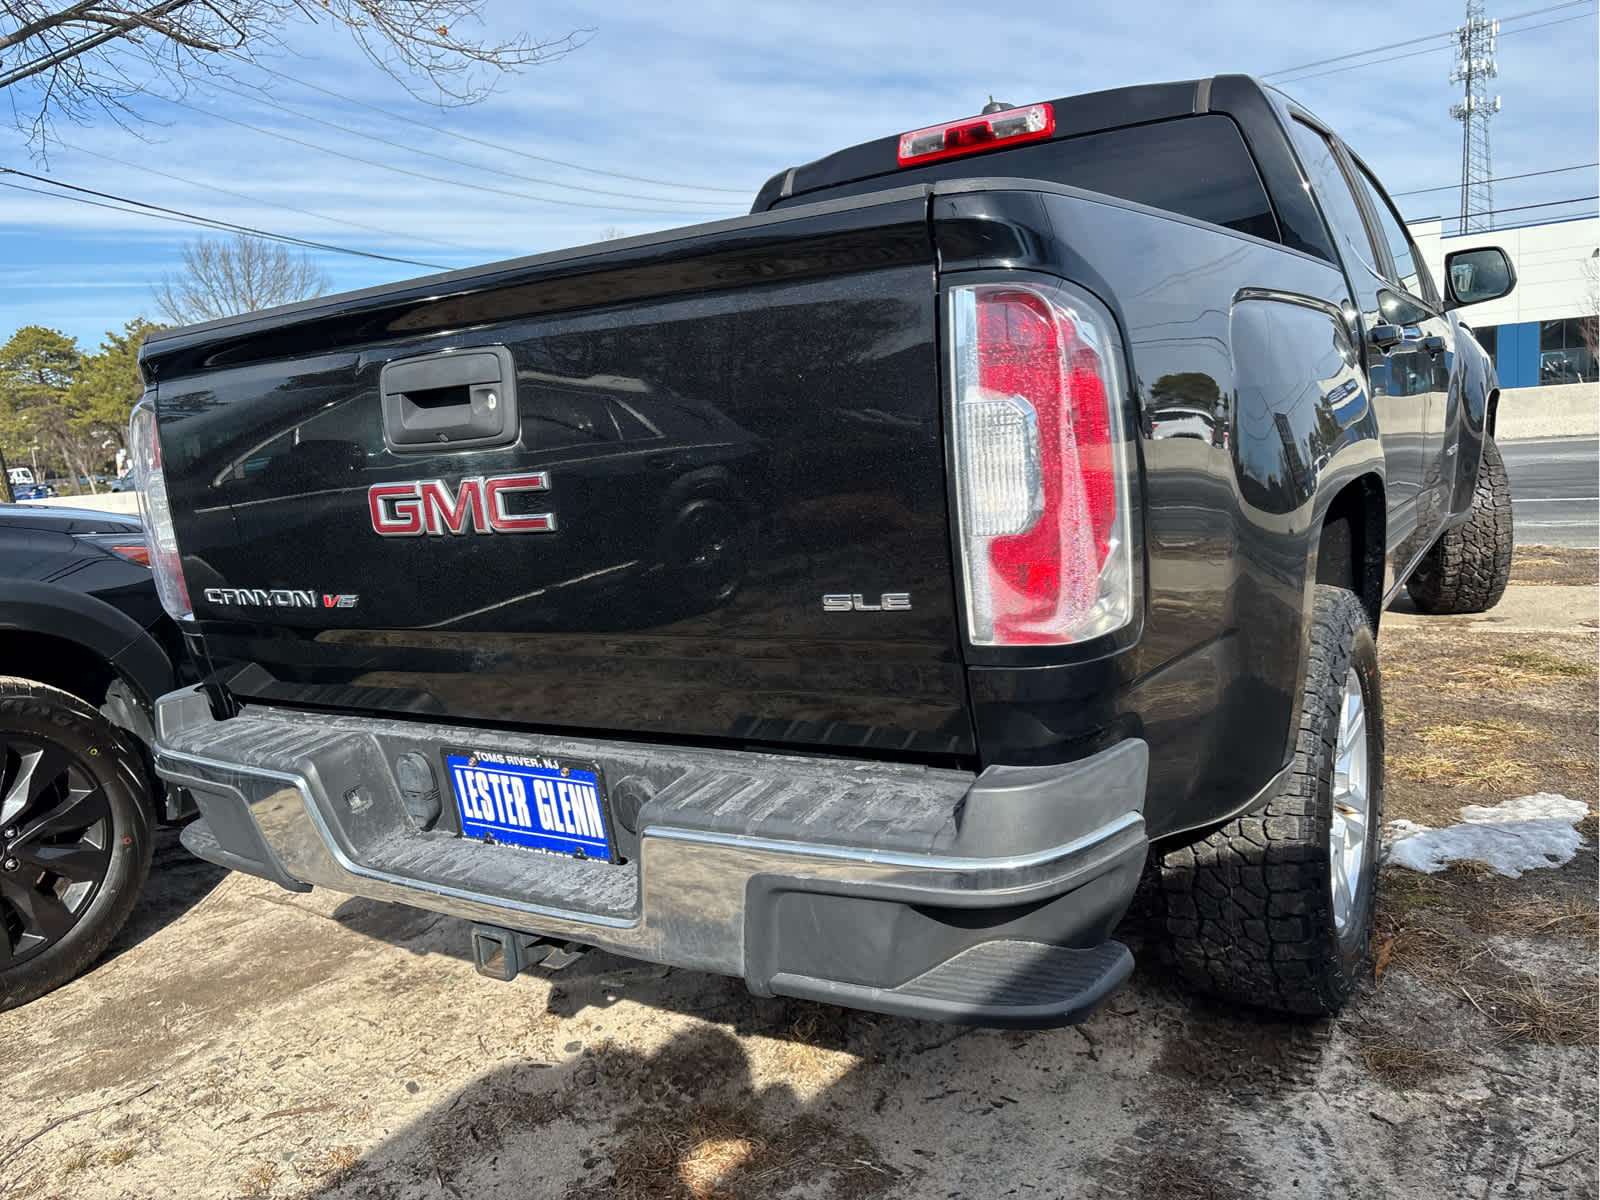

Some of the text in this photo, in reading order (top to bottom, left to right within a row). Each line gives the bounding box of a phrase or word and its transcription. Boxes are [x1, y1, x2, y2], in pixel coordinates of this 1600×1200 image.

[368, 472, 557, 536] GMC
[204, 588, 360, 608] CANYON V6
[822, 592, 912, 611] SLE
[473, 751, 505, 764] TOMS
[543, 758, 560, 769] NJ
[454, 769, 605, 839] LESTER GLENN
